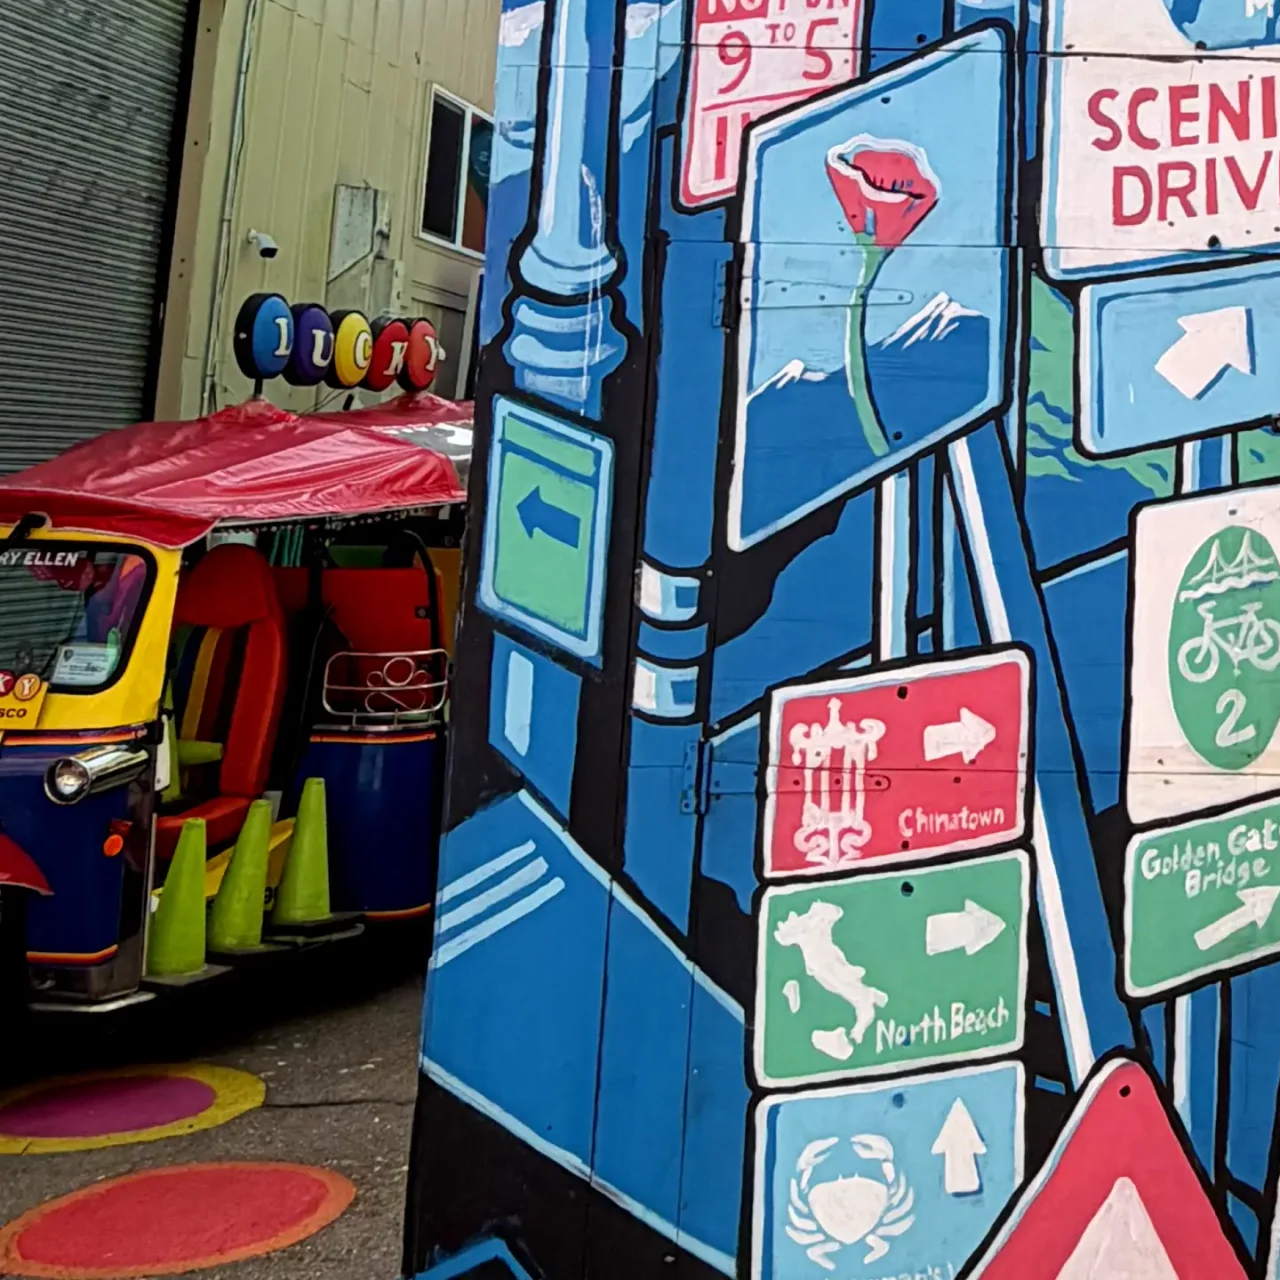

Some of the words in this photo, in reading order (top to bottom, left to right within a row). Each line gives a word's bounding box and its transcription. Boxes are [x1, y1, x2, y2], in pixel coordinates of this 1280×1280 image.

[718, 31, 752, 94] 9
[765, 22, 796, 44] TO
[802, 18, 839, 80] 5
[24, 552, 78, 567] ELLEN
[1214, 687, 1256, 749] 2
[898, 805, 1005, 837] Chinatown
[1141, 839, 1221, 880] Golden
[1184, 856, 1271, 899] Bridge
[876, 1004, 947, 1054] North
[950, 995, 1009, 1041] Beach
